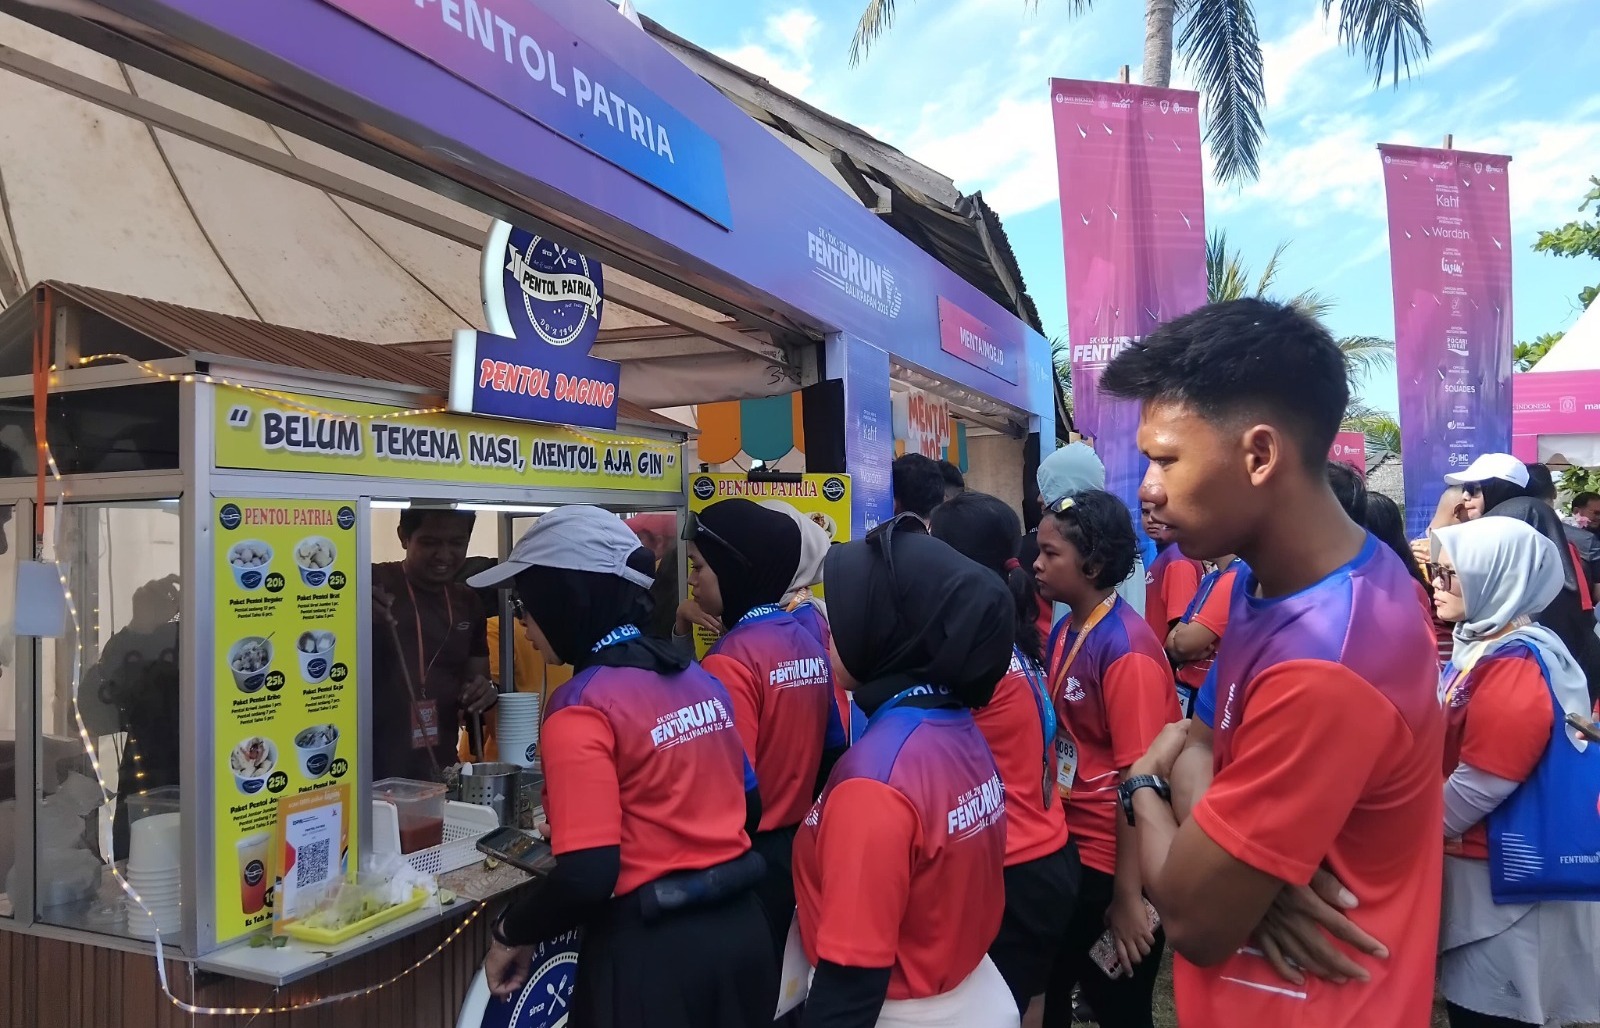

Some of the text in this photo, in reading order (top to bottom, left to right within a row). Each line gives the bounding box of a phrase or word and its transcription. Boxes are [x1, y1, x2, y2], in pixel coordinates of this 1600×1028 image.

[417, 0, 674, 164] ENTOL PATRIA
[1436, 194, 1459, 208] Kahf
[1432, 226, 1470, 240] Wardah
[808, 230, 882, 299] FENTURUN
[522, 270, 592, 299] PENTOL PATRIA
[959, 327, 1004, 367] MENTAIMOE.ID
[479, 358, 616, 408] PENTOL DAGING
[1444, 384, 1476, 394] SQUADES
[908, 394, 949, 438] MENTAI
[263, 412, 360, 452] BELUM
[372, 424, 461, 460] TEKENA
[470, 434, 524, 469] NASI,
[532, 441, 597, 470] MENTOL
[604, 448, 632, 473] AJA
[637, 452, 662, 474] GIN
[919, 433, 942, 461] MOE
[718, 480, 818, 498] PENTOL PATRIA
[245, 508, 333, 526] PENTOL PATRIA
[266, 577, 283, 588] 20k
[329, 575, 345, 585] 25k
[331, 666, 346, 677] 25k
[266, 675, 283, 687] 25k
[331, 763, 347, 774] 30k
[268, 777, 285, 788] 25k
[529, 1002, 545, 1017] since
